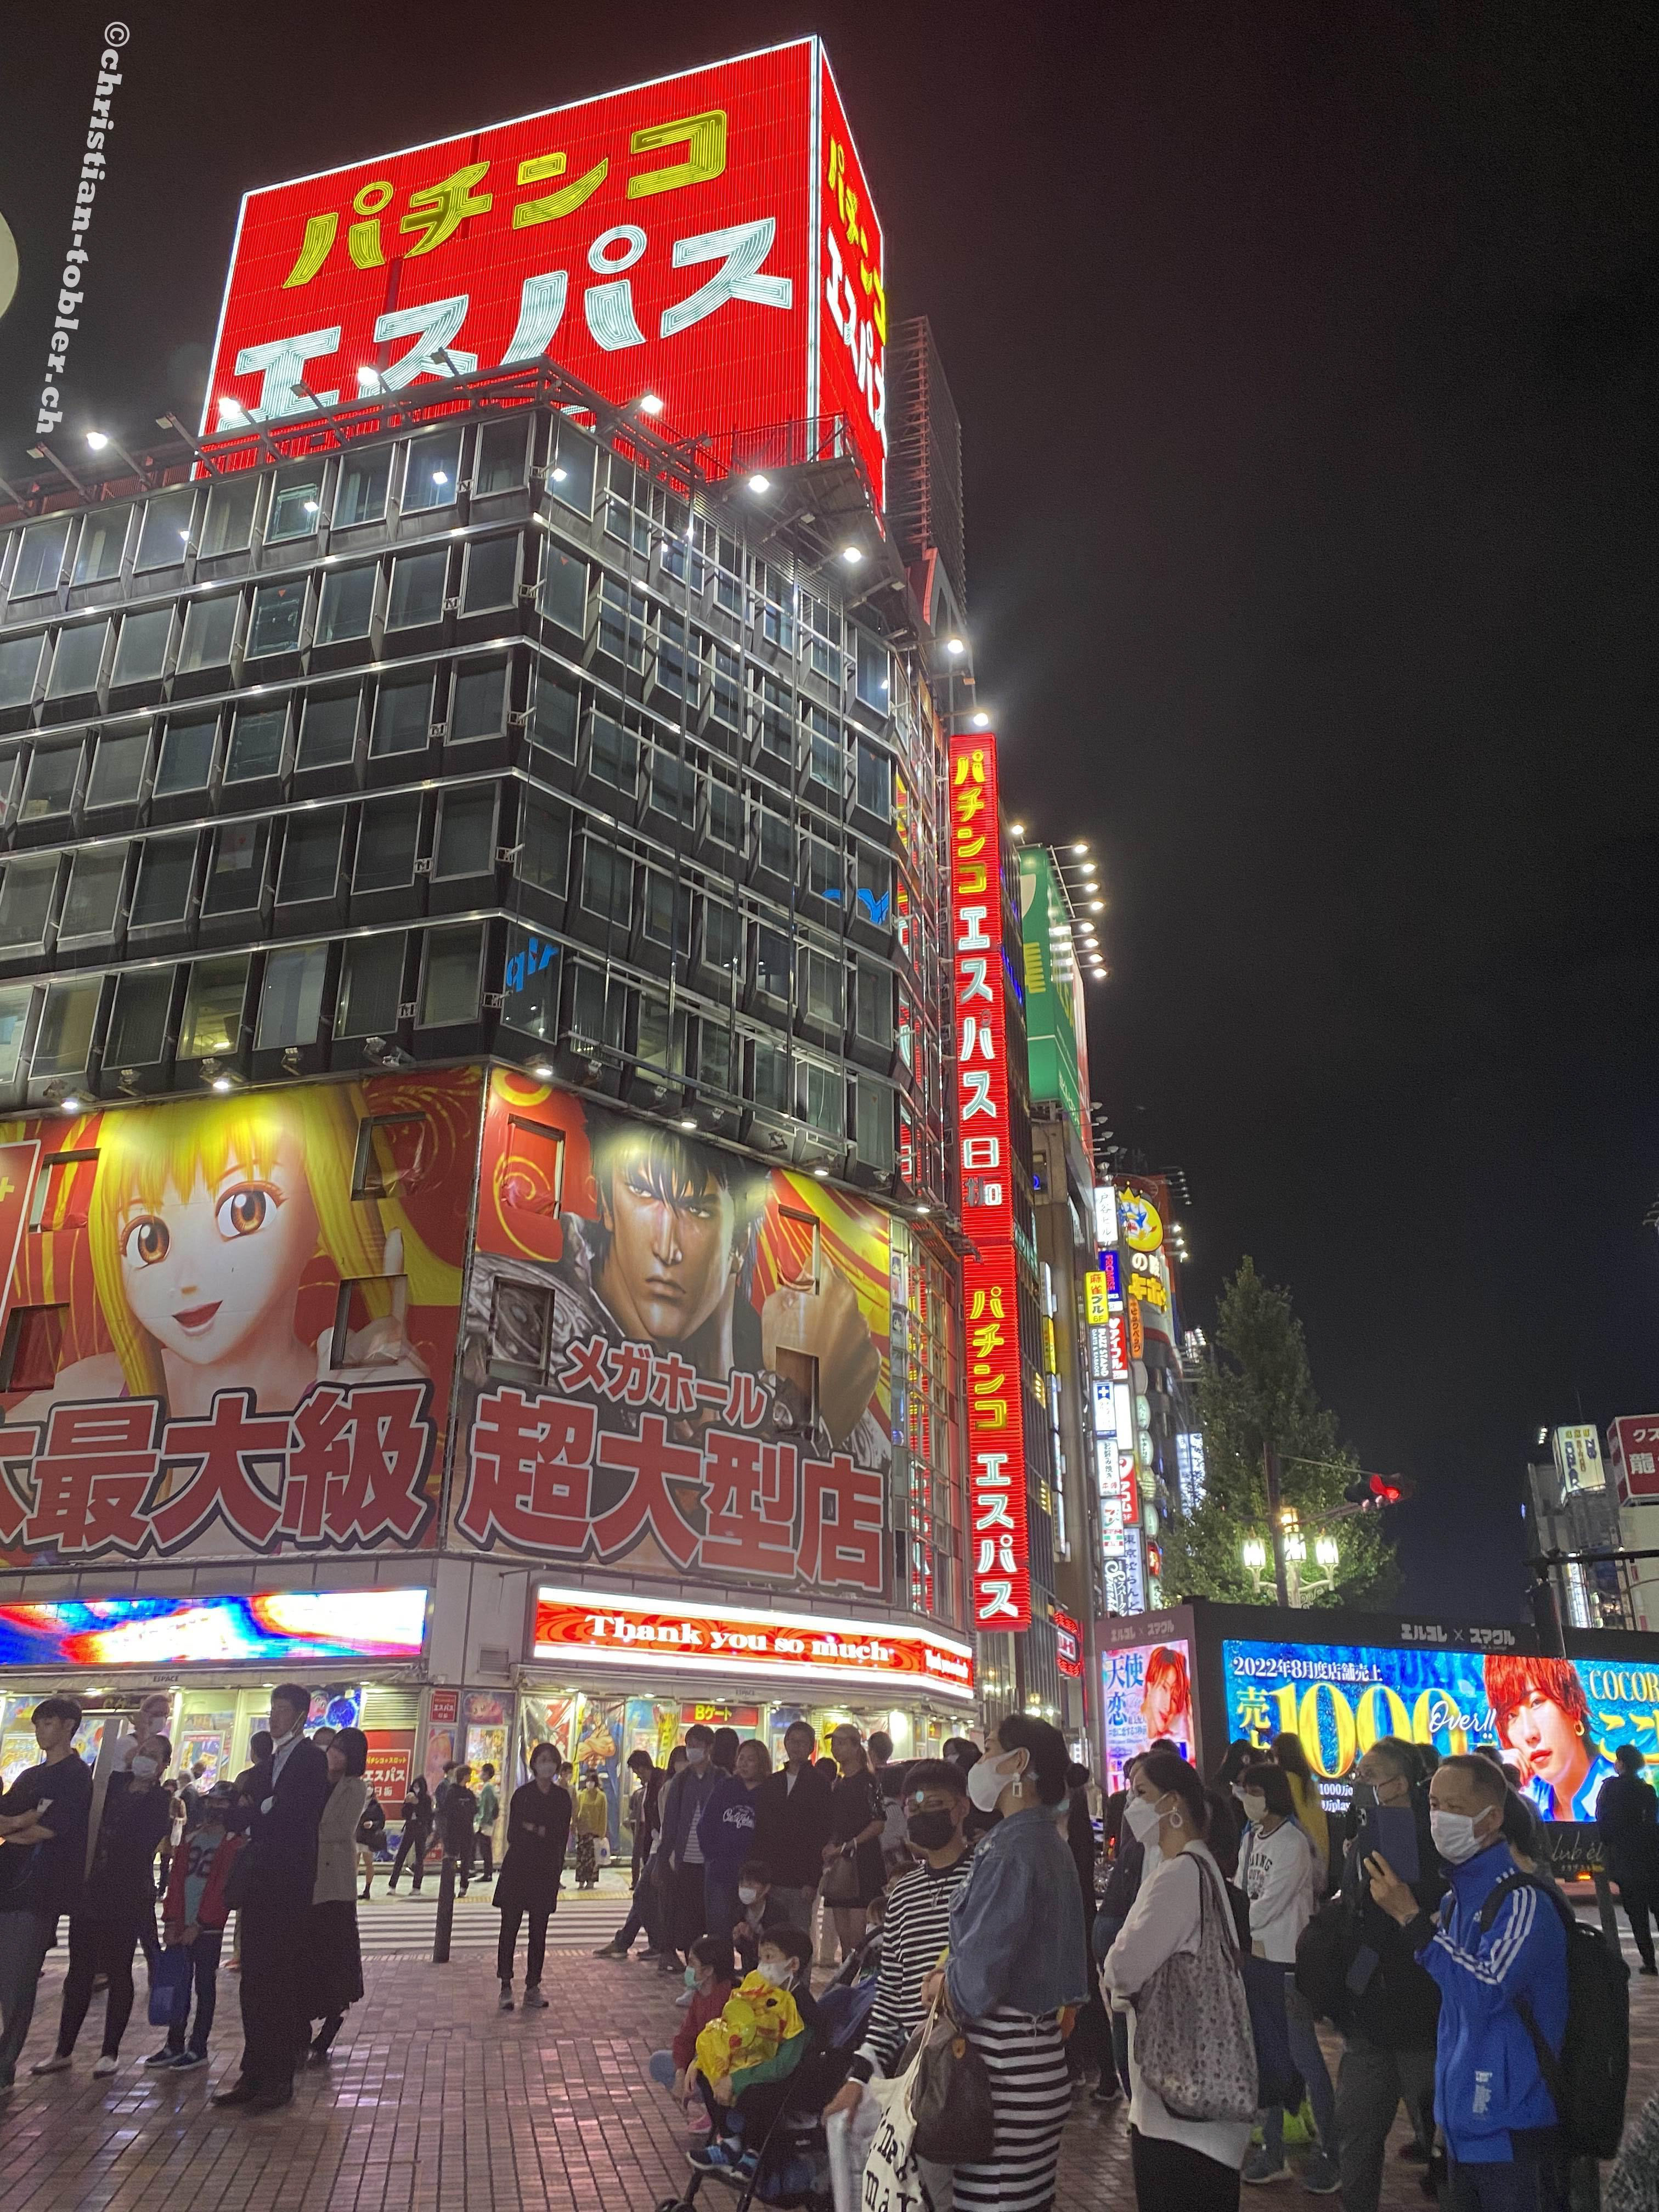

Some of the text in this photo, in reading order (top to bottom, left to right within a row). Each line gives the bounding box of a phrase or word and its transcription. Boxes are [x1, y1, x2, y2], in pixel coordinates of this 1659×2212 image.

[283, 110, 727, 289] パチンコ
[830, 134, 887, 346] パチンコ
[218, 217, 792, 432] エスパス
[955, 750, 986, 894] パチンコ
[558, 1335, 768, 1429] メガホール
[1110, 1329, 1123, 1369] アイフル
[970, 1286, 1018, 1619] パチンコ エスパス
[458, 1386, 884, 1593] 超大型店
[585, 1615, 890, 1662] Thank you so much
[1106, 1654, 1144, 1690] 天使
[1233, 1656, 1383, 1682] 2022年8月度店舗売上
[695, 1703, 732, 1722] Bゲート
[1429, 1701, 1497, 1739] Over!!
[363, 1766, 405, 1782] エスパス
